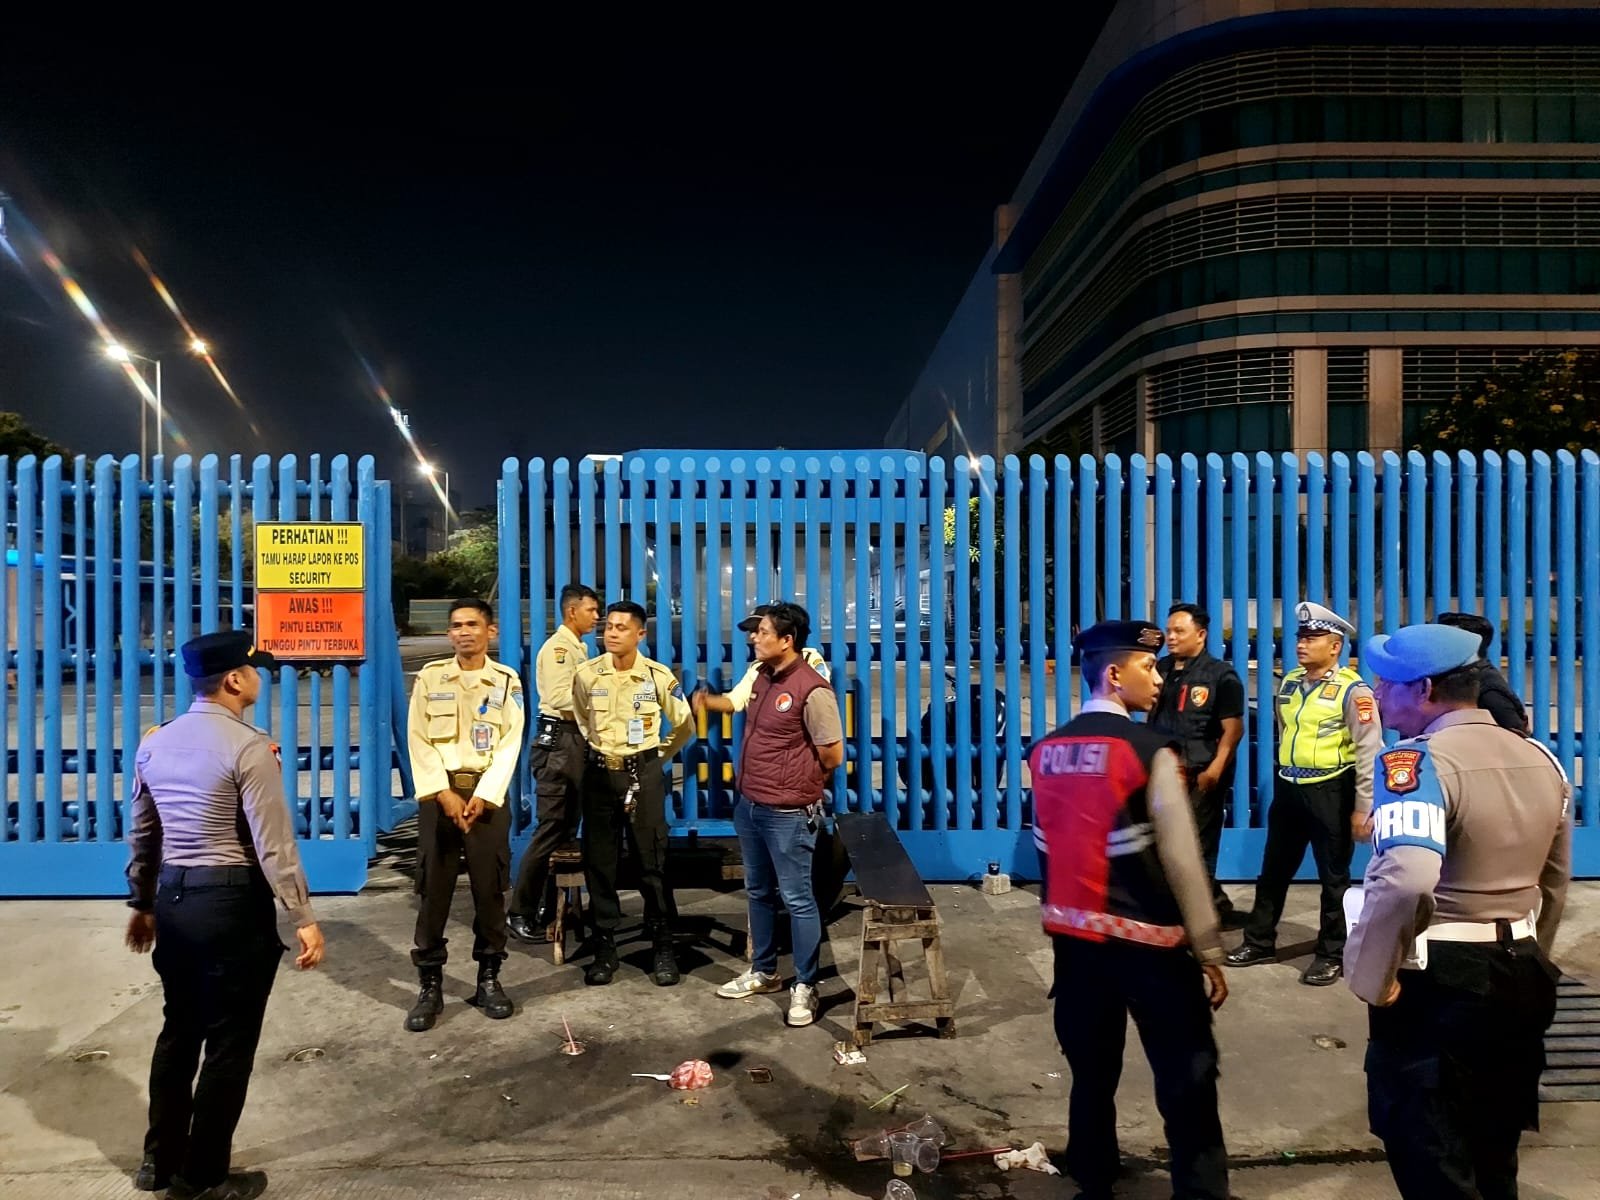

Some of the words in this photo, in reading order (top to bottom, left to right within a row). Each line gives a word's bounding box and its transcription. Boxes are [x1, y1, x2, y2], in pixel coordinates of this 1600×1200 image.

[272, 529, 334, 544] PERHATIAN
[337, 529, 348, 544] !!!
[262, 553, 280, 565] TAMU
[283, 553, 307, 565] HARAP
[309, 553, 332, 565] LAPOR
[333, 553, 343, 565] KE
[344, 553, 359, 565] POS
[289, 572, 331, 584] SECURITY
[288, 598, 319, 613] AWAS
[321, 598, 333, 613] !!!
[279, 621, 304, 633] PINTU
[305, 621, 343, 633] ELEKTRIK
[262, 639, 296, 651] TUNGGU
[298, 639, 321, 651] PINTU
[323, 639, 359, 651] TERBUKA
[1040, 744, 1109, 775] POLISI
